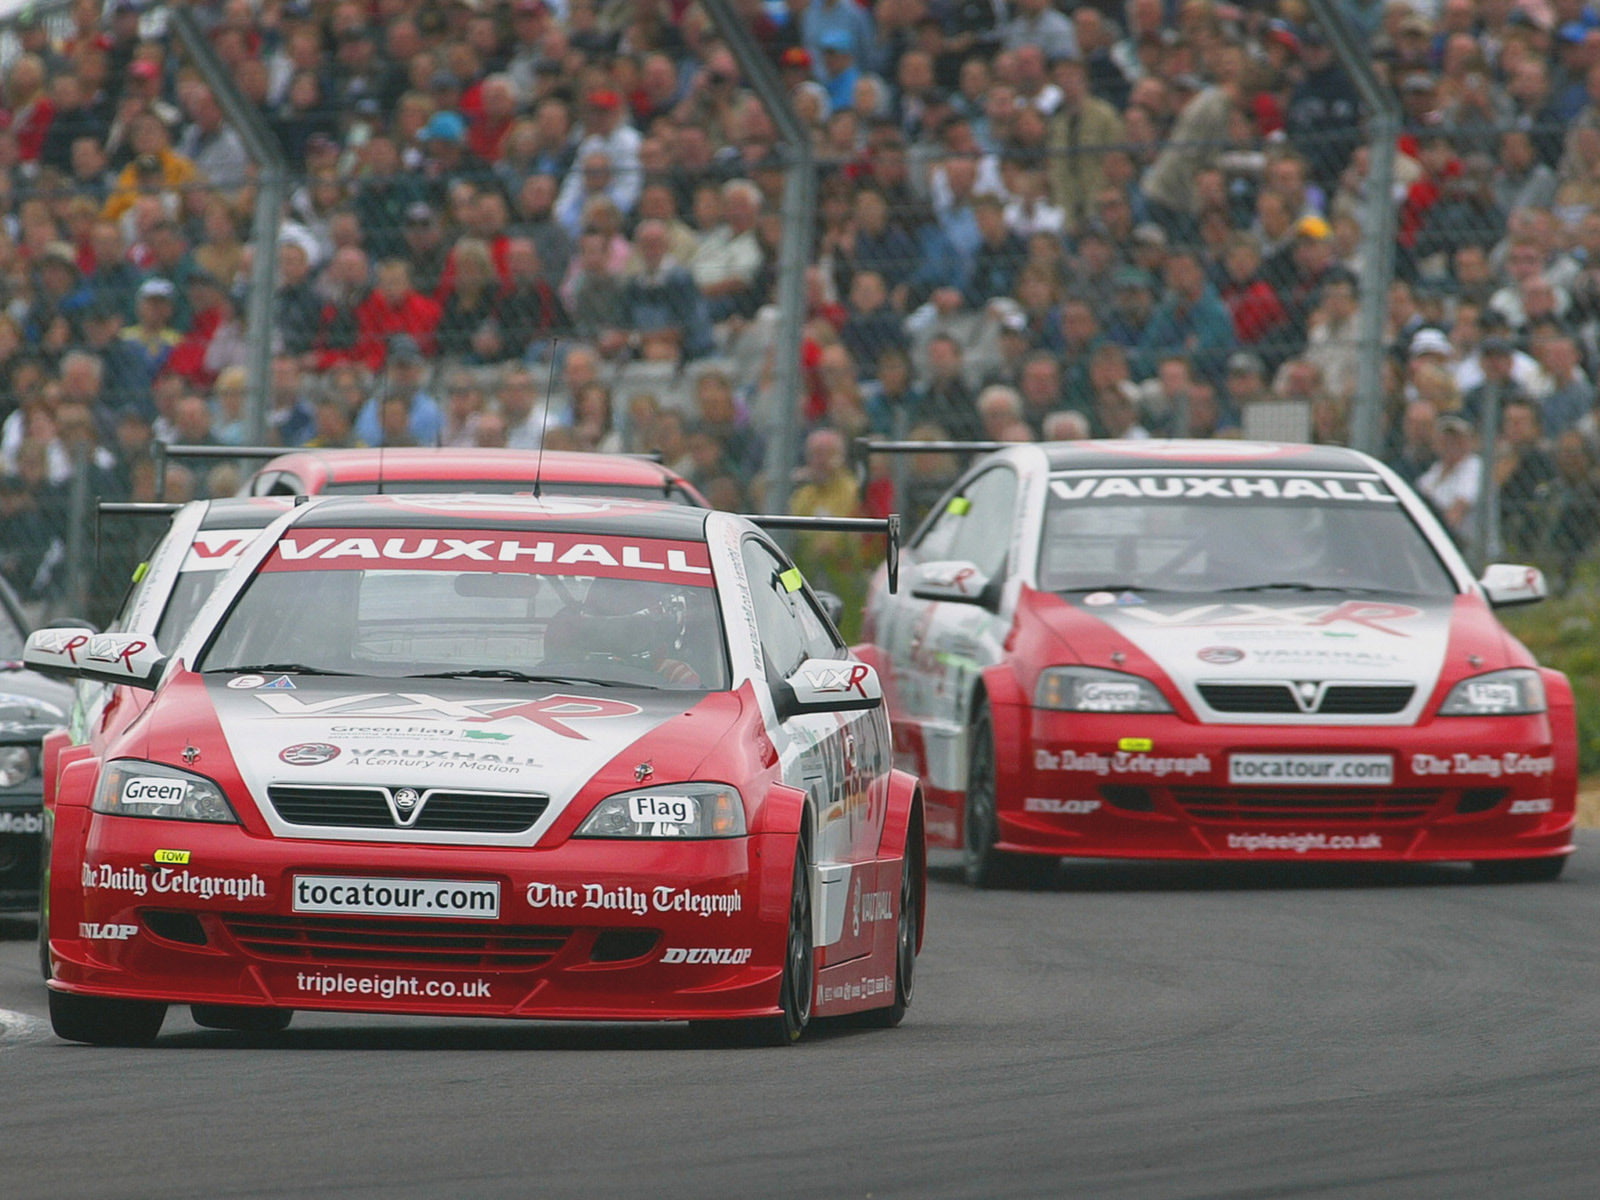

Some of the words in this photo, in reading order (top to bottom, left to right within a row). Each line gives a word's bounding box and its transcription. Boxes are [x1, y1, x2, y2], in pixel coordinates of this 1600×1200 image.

[1049, 477, 1398, 502] VAUXHALL
[279, 538, 710, 575] VAUXHALL
[33, 632, 88, 664] VXR
[88, 637, 147, 673] VXR
[803, 665, 869, 699] VXR
[252, 693, 644, 741] VXR
[330, 725, 401, 734] Green
[407, 726, 454, 736] Flag
[347, 757, 360, 766] A
[366, 757, 435, 768] Century
[439, 758, 453, 768] in
[456, 761, 520, 774] Motion
[351, 749, 543, 768] VAUXHALL
[1232, 755, 1392, 778] tocatour.com
[126, 781, 183, 801] Green
[636, 796, 688, 822] Flag
[1226, 831, 1382, 853] tripleeight.co.uk
[160, 851, 185, 862] TOW
[99, 863, 148, 896] Daily
[151, 866, 266, 901] Telegraph
[298, 880, 495, 911] tocatour.com
[526, 881, 578, 909] The
[582, 883, 648, 916] Daily
[652, 885, 742, 917] Telegraph
[659, 947, 752, 965] DUNLOP
[296, 971, 491, 999] tripleeight.co.uk
